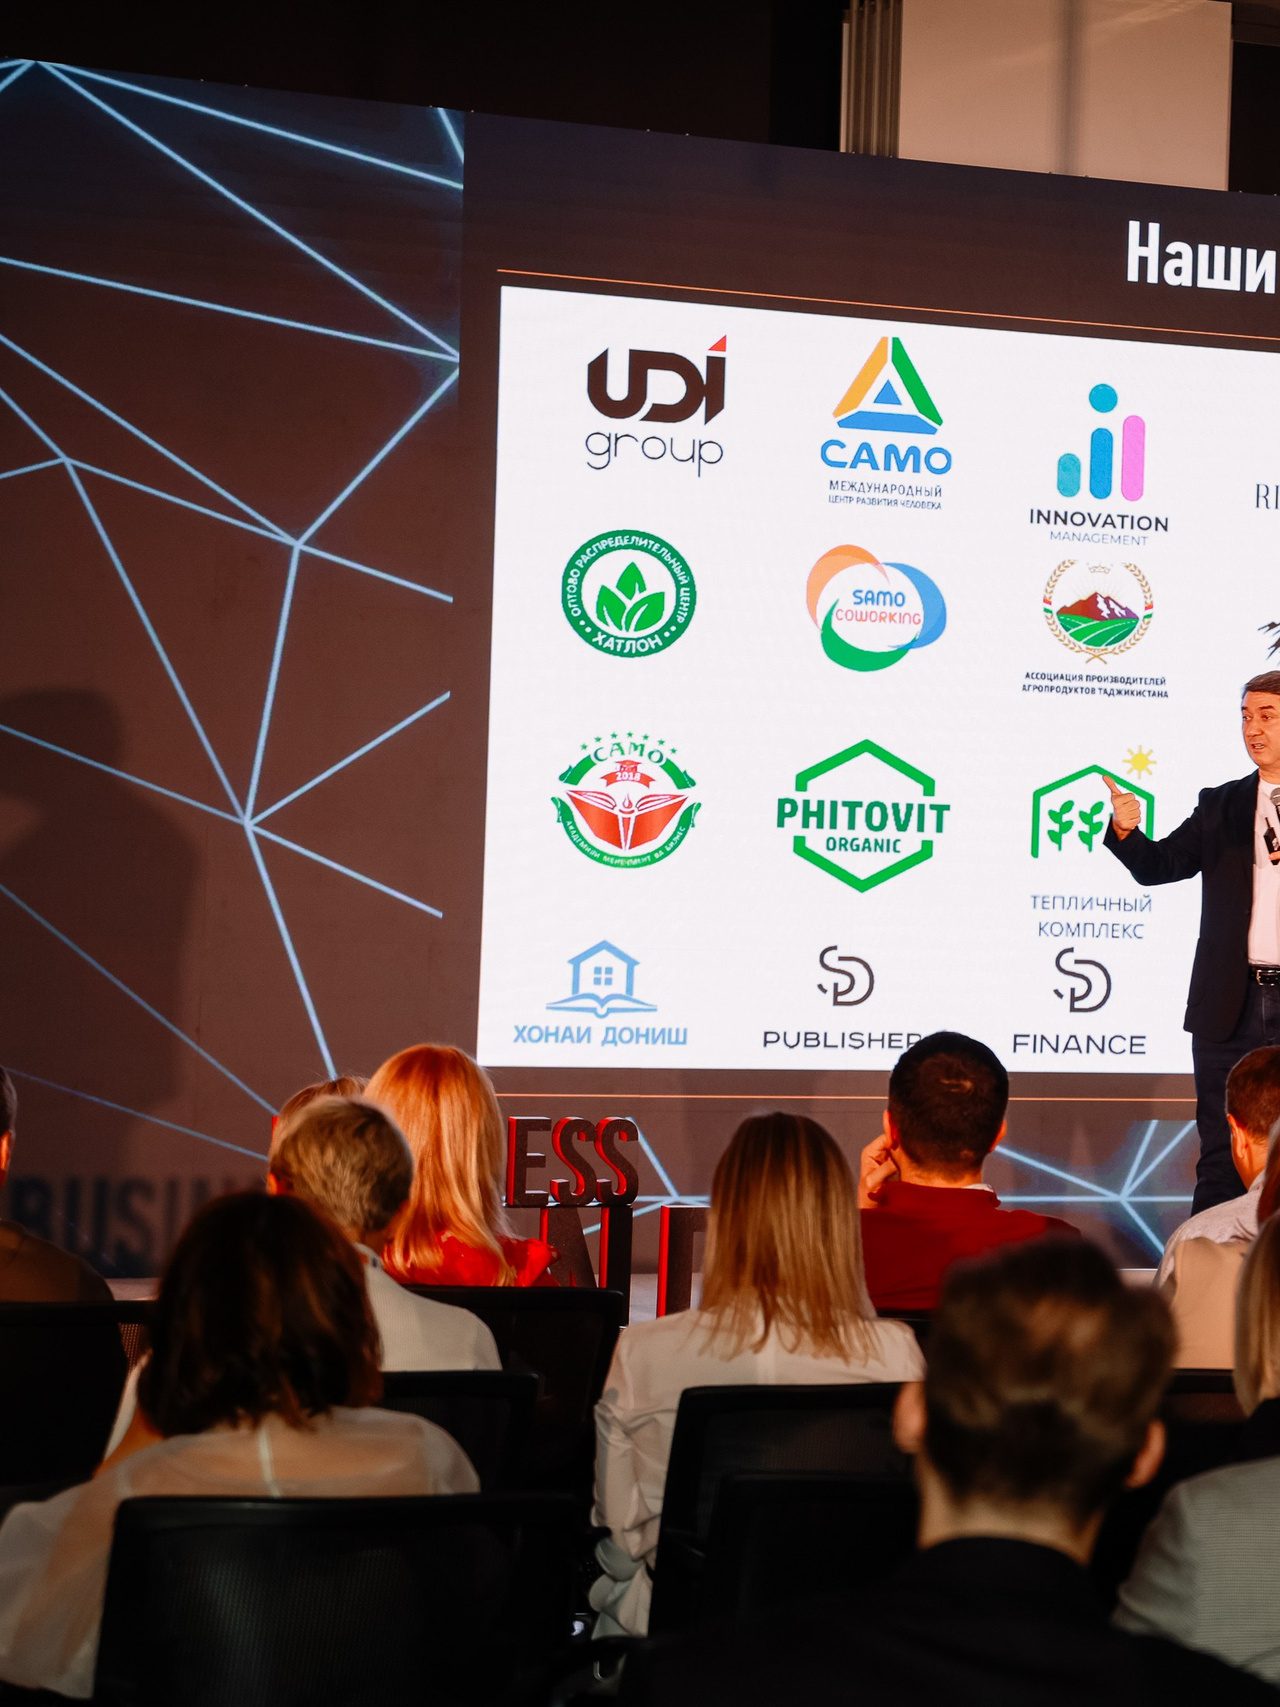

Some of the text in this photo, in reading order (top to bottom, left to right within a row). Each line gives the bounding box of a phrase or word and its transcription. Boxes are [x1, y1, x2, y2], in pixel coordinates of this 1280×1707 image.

[1126, 219, 1277, 294] Наши
[585, 431, 724, 478] group
[829, 480, 942, 498] МЕЖДУНАРОДНЫЙ
[828, 494, 942, 510] ЦЕНТР РАЗВИТИЯ ЧЕЛОВЕКА
[1030, 508, 1169, 532] INNOVATION
[1050, 531, 1149, 546] MANAGEMENT
[566, 535, 691, 623] ОПТОВО РАСПРЕДЕЛИТЕЛЬНЫЙ ЦЕНТР
[852, 589, 906, 607] SAMO
[835, 608, 922, 625] COWORKING
[592, 631, 663, 654] ХАТЛОН
[1025, 671, 1166, 686] АССОЦИАЦИЯ ПРОИЗВОДИТЕЛЕЙ
[1022, 684, 1170, 699] АГРОПРОДУКТОВ ТАДЖИКИСТАНА
[615, 770, 642, 782] 2018
[777, 798, 951, 833] PHITOVIT
[826, 836, 901, 853] ORGANIC
[1031, 894, 1152, 912] ТЕПЛИЧНЫЙ
[1038, 921, 1144, 939] КОМПЛЕКС
[513, 1025, 688, 1046] ХОНАИ ДОНИШ
[1013, 1034, 1147, 1055] FINANCE
[505, 1116, 639, 1206] ESS
